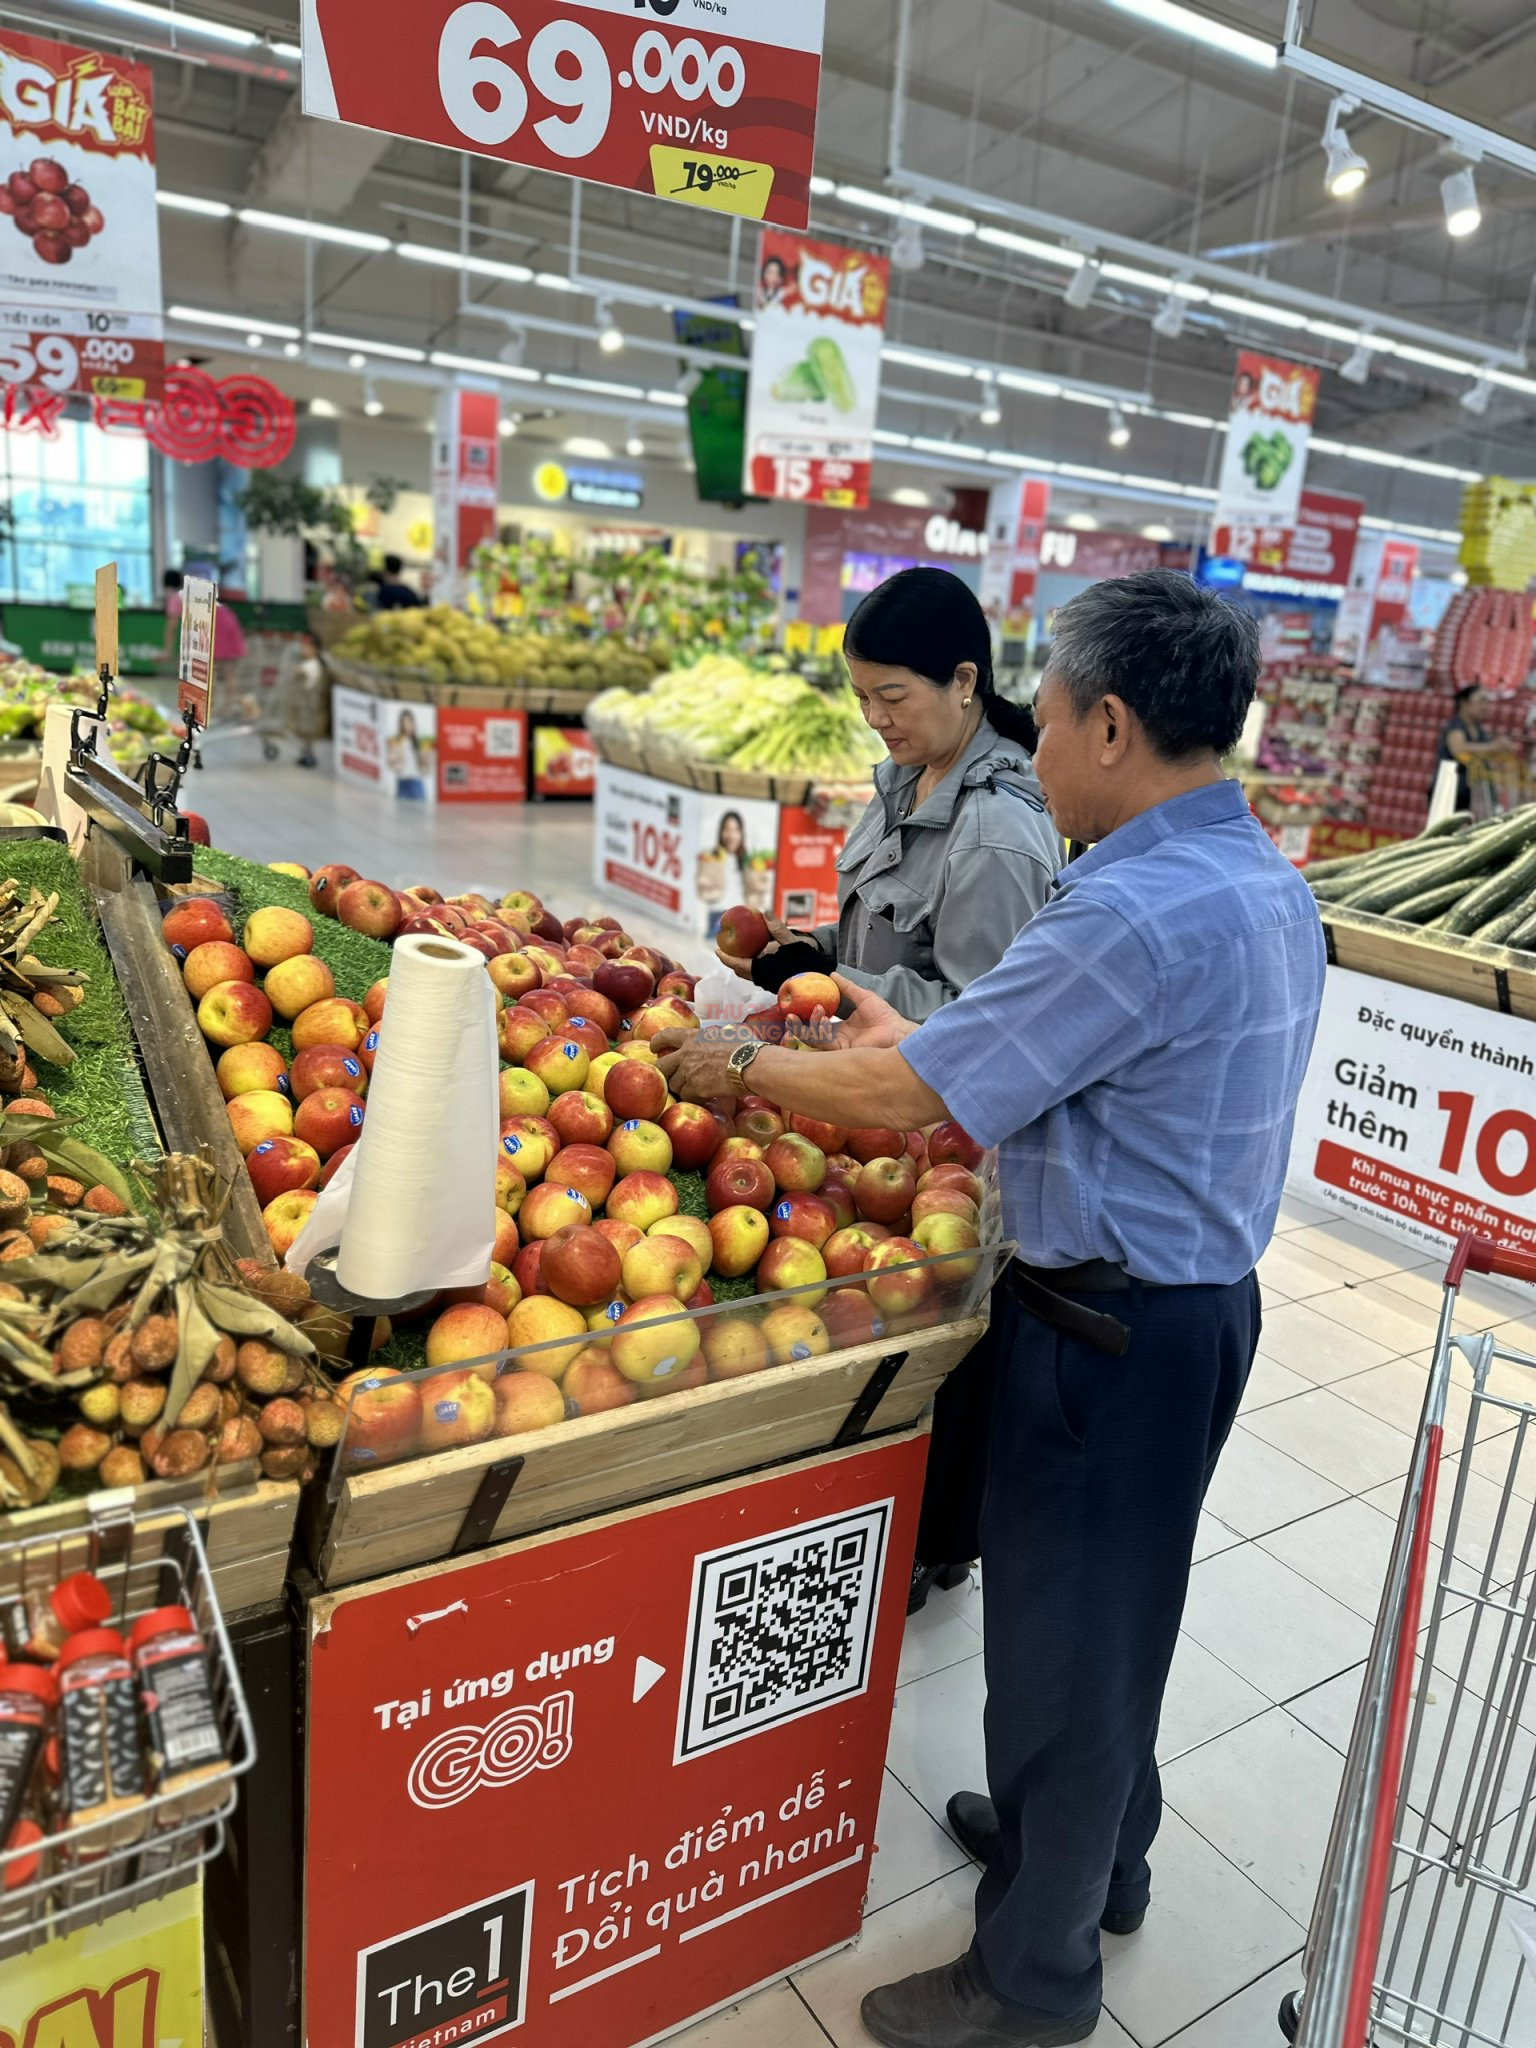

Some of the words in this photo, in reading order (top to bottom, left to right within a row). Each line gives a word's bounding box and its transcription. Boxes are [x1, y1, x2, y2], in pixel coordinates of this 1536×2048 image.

[438, 1, 746, 158] 69.000
[639, 110, 729, 149] VND/kg
[683, 161, 740, 192] 79.000
[1358, 1006, 1395, 1032] Đặc
[1400, 1023, 1464, 1054] quyền
[1470, 1041, 1534, 1075] thành
[1335, 1058, 1418, 1109] Giảm
[1327, 1099, 1409, 1152] thêm
[1349, 1176, 1388, 1201] trước
[1392, 1192, 1422, 1216] 10h.
[1428, 1207, 1448, 1225] Từ
[1352, 1157, 1376, 1176] Khi
[1379, 1170, 1411, 1191] mua
[1415, 1183, 1450, 1208] thực
[1453, 1201, 1499, 1228] phẩm
[1360, 1203, 1375, 1216] cho
[1376, 1210, 1395, 1225] toàn
[374, 1688, 431, 1730] Tại
[443, 1669, 514, 1709] ứng
[525, 1636, 615, 1680] dụng
[407, 1690, 574, 1809] GO!
[558, 1853, 650, 1914] Tích
[664, 1805, 765, 1870] điểm
[779, 1769, 826, 1821] dễ
[552, 1901, 633, 1969] Đổi
[646, 1871, 724, 1931] quà
[739, 1811, 856, 1887] nhanh
